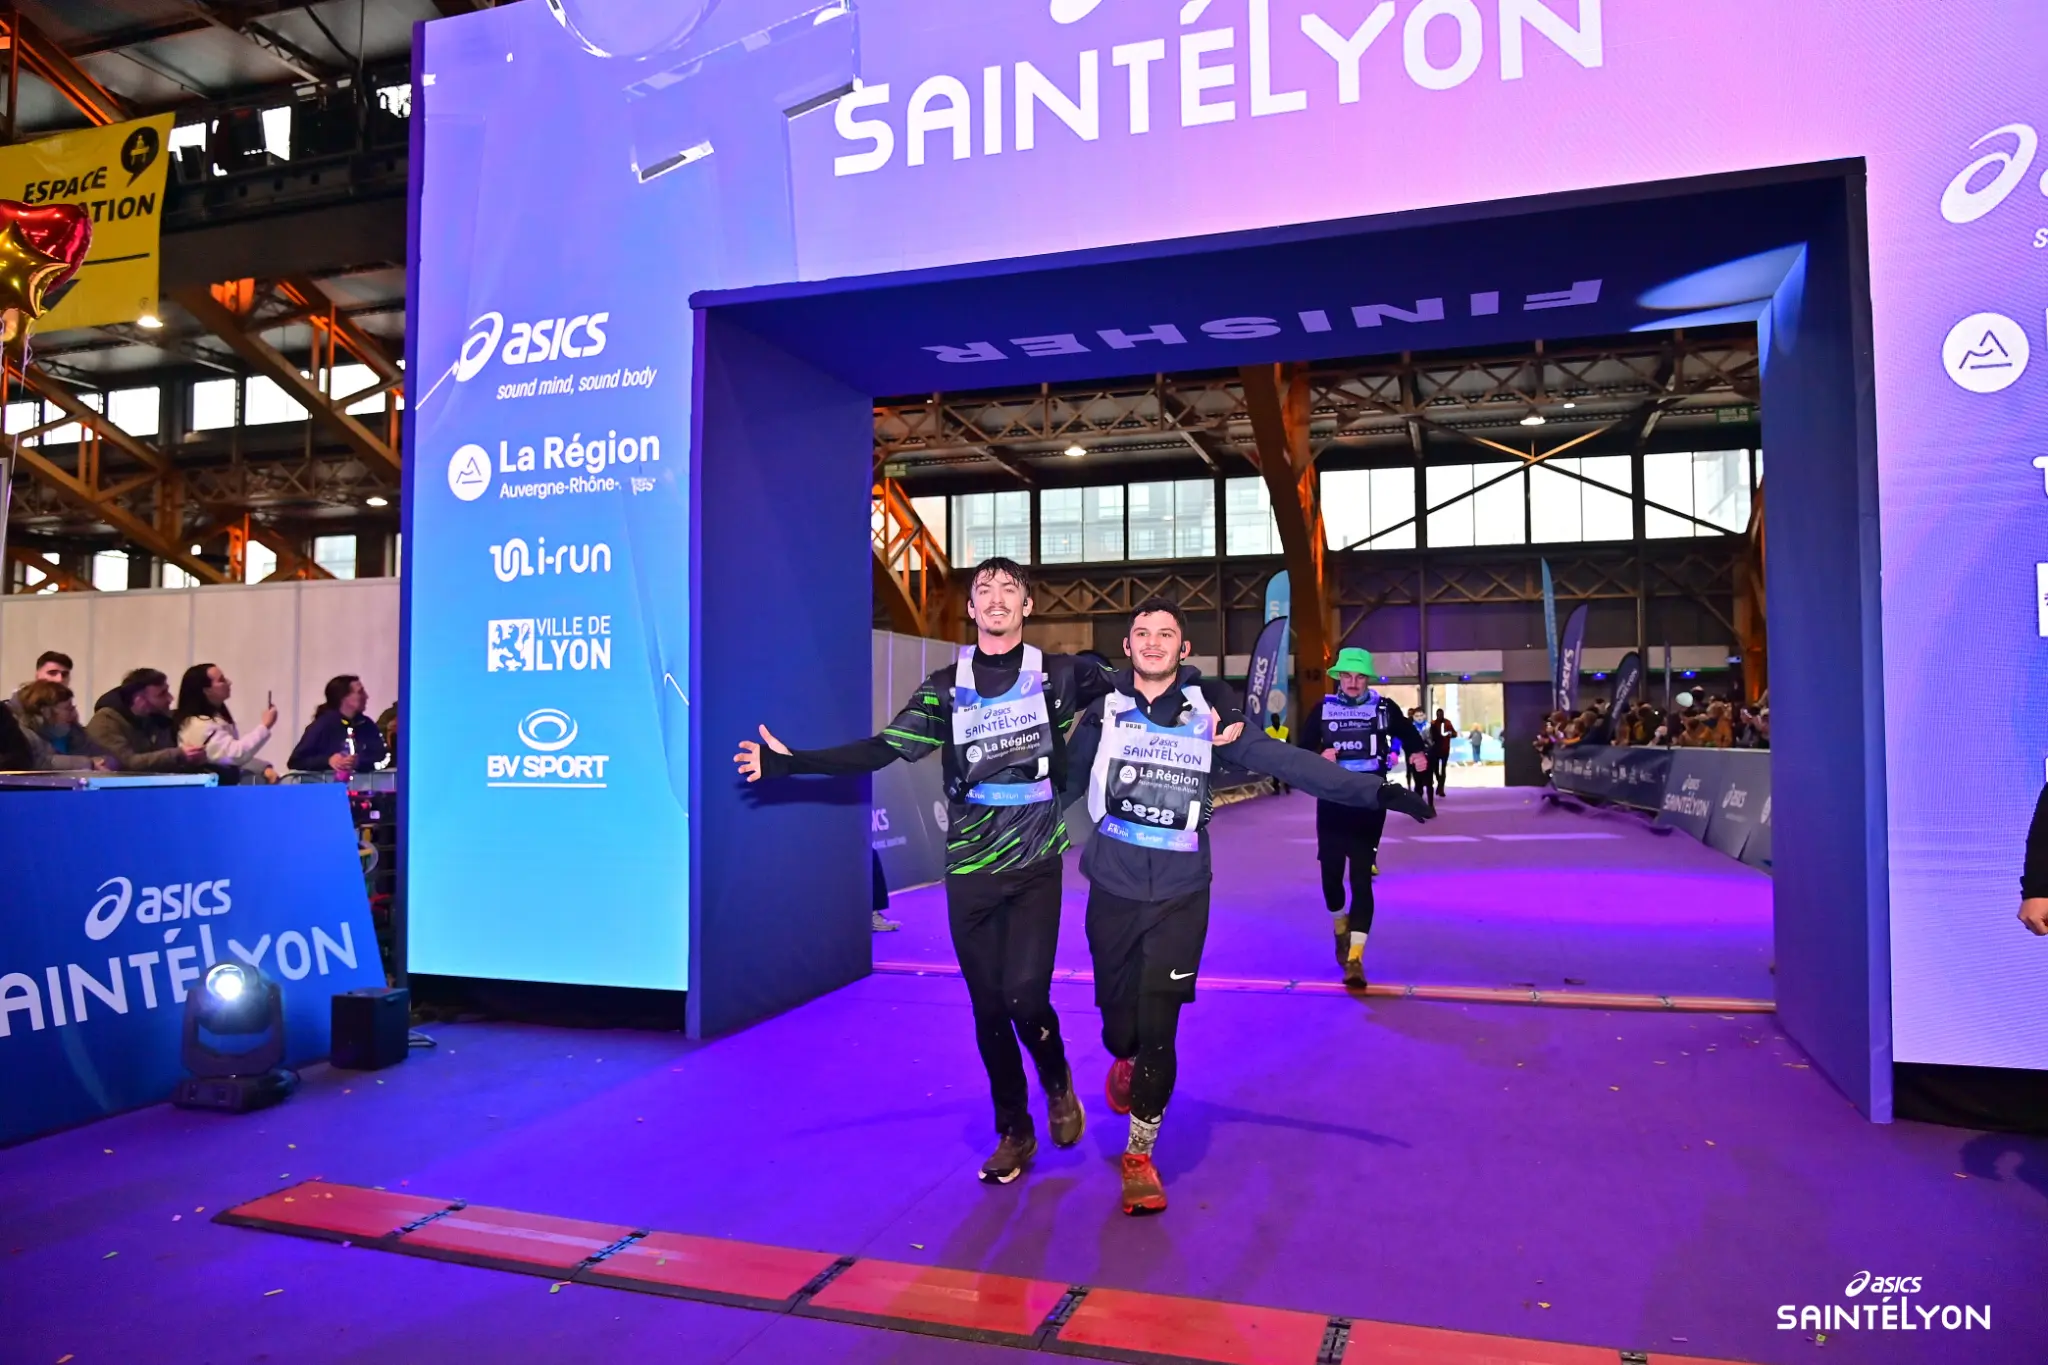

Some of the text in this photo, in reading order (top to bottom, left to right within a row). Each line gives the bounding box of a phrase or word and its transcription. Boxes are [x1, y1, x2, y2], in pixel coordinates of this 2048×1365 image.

[834, 0, 1604, 176] SAINTÉLYON
[23, 166, 108, 203] ESPACE
[79, 193, 155, 223] TION
[921, 279, 1603, 364] FINISHER
[496, 366, 657, 400] sound mind, sound body
[499, 430, 660, 474] La Région
[538, 536, 611, 575] i-run
[536, 615, 611, 636] VILLE DE
[536, 638, 611, 671] LYON
[984, 731, 1040, 753] La Région
[1333, 741, 1363, 751] 9160
[487, 755, 610, 779] BV SPORT
[1140, 767, 1199, 787] La Région
[1121, 799, 1175, 826] 9828
[0, 921, 358, 1038] AINTÉLYON
